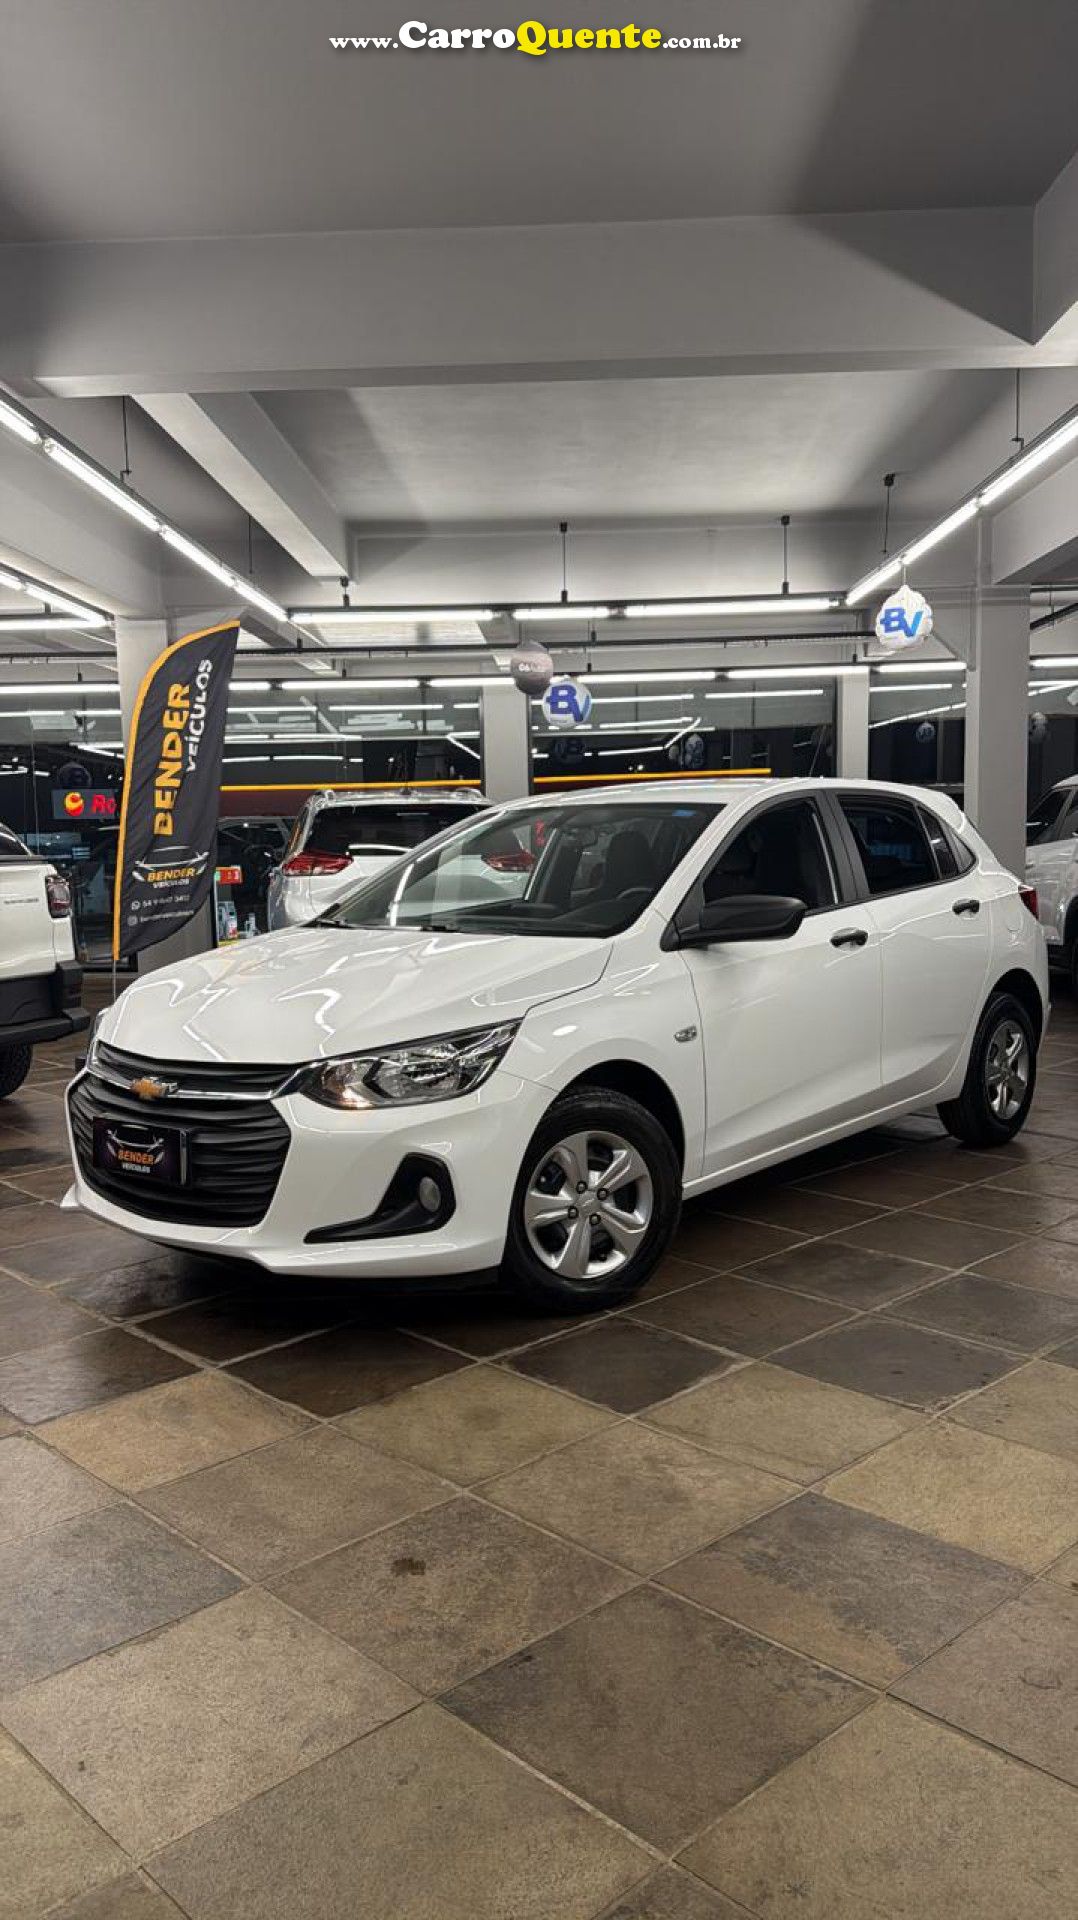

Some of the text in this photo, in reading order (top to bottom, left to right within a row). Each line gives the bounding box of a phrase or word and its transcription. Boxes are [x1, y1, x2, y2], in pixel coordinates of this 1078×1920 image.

[880, 608, 924, 638] BV
[546, 684, 590, 723] BV
[153, 683, 190, 836] BENDER
[147, 867, 196, 883] BENDER
[118, 1149, 154, 1165] BENDER
